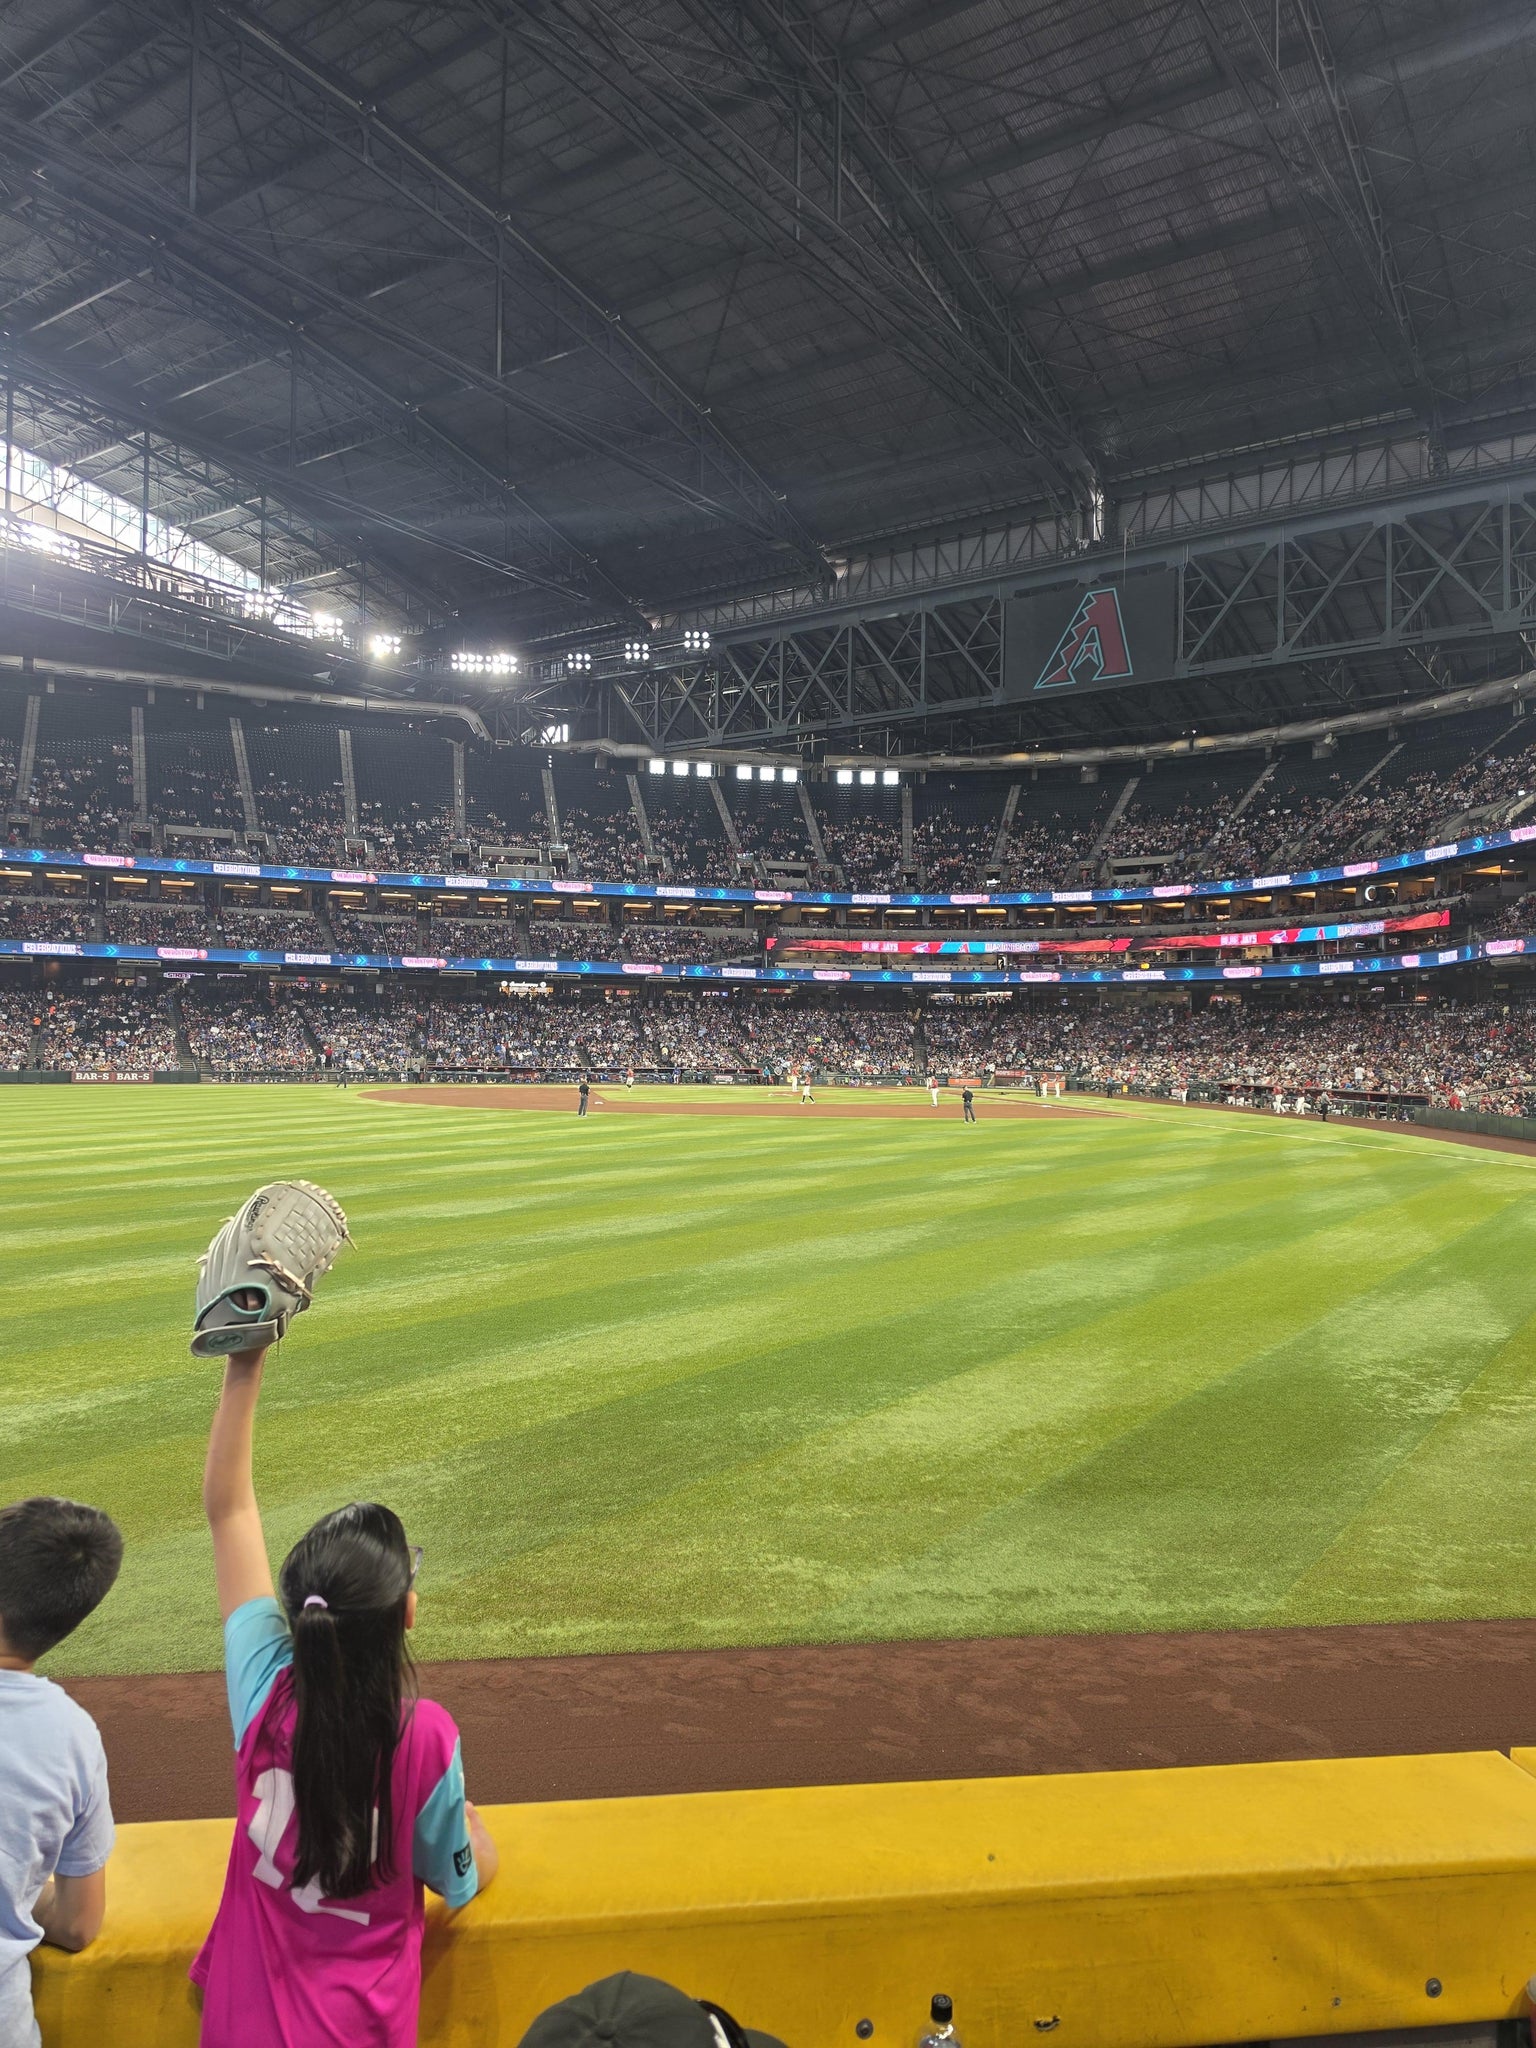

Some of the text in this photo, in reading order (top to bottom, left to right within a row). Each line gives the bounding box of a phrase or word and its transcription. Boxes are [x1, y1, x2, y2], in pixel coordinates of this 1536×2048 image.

[1034, 587, 1134, 690] A
[75, 1072, 109, 1081] BAR-S
[116, 1072, 150, 1081] BAR-S
